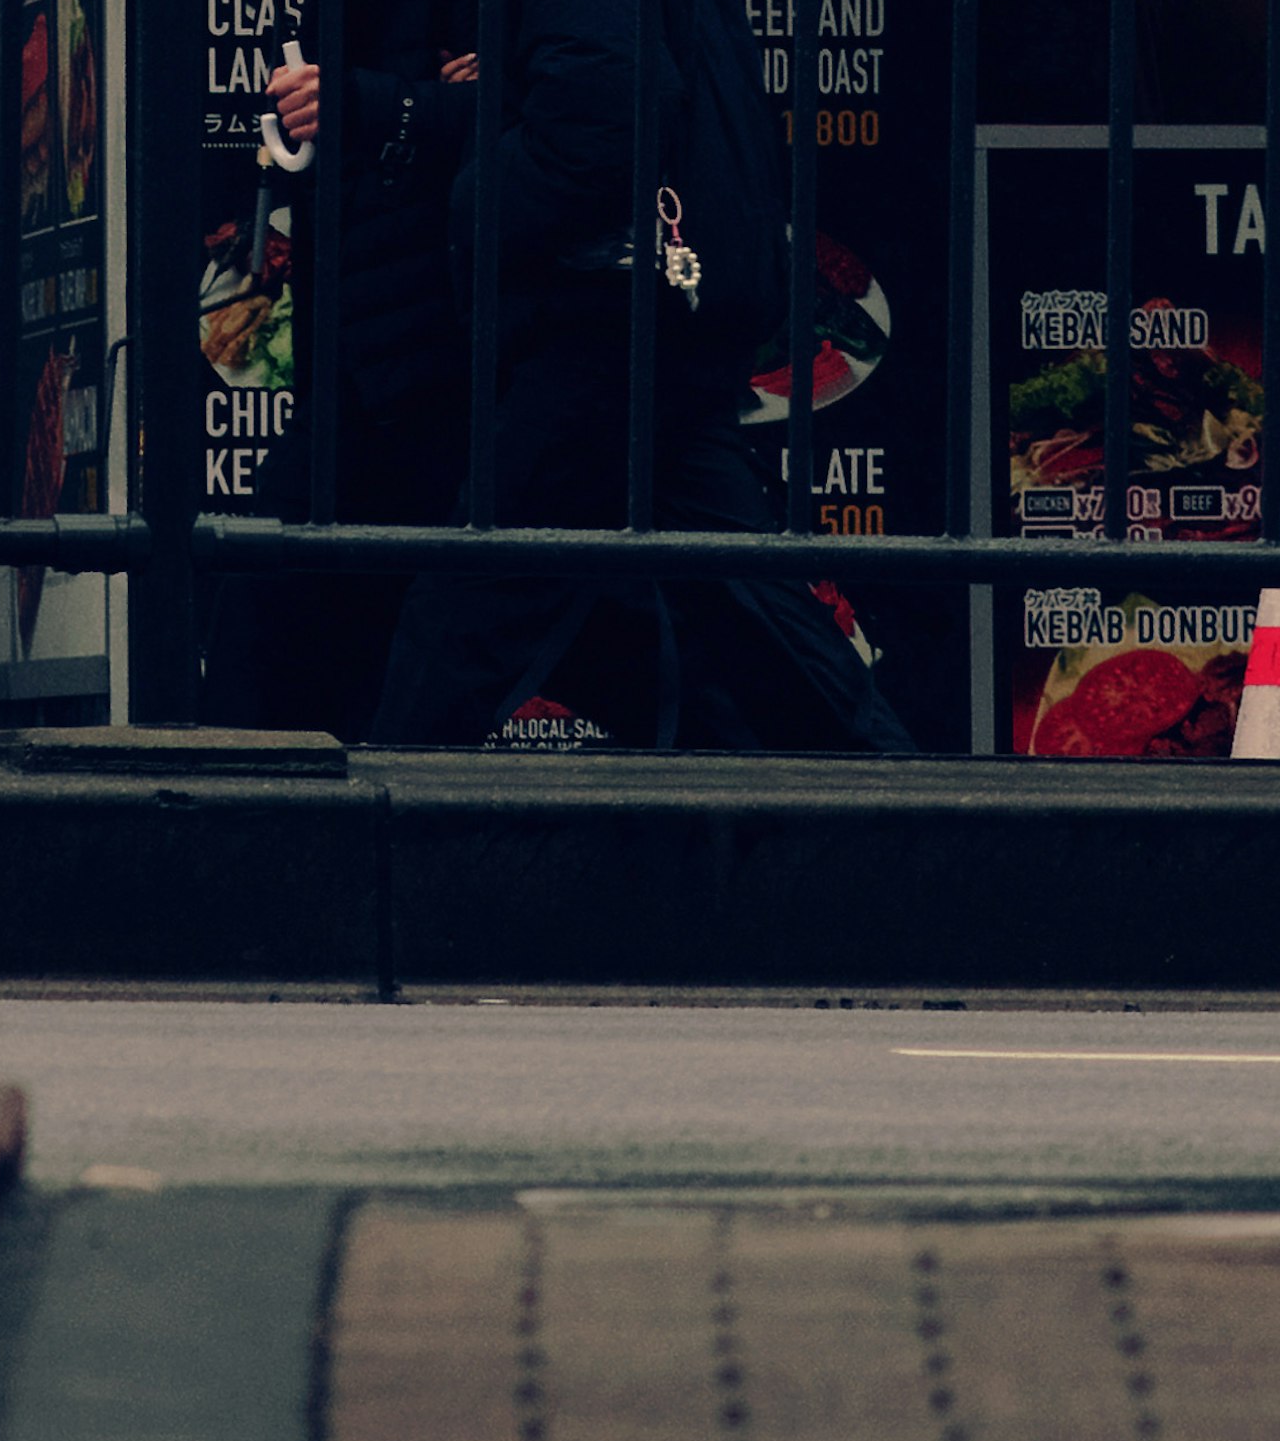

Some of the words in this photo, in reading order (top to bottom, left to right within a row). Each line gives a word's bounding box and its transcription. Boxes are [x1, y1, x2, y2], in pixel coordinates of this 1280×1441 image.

[817, 47, 885, 95] OAST
[1128, 309, 1209, 349] SAND
[819, 503, 885, 536] 500
[1025, 495, 1071, 513] CHICKEN
[1182, 493, 1213, 512] BEEF
[1026, 606, 1124, 645] KEBAB
[1136, 606, 1257, 645] DONBUR
